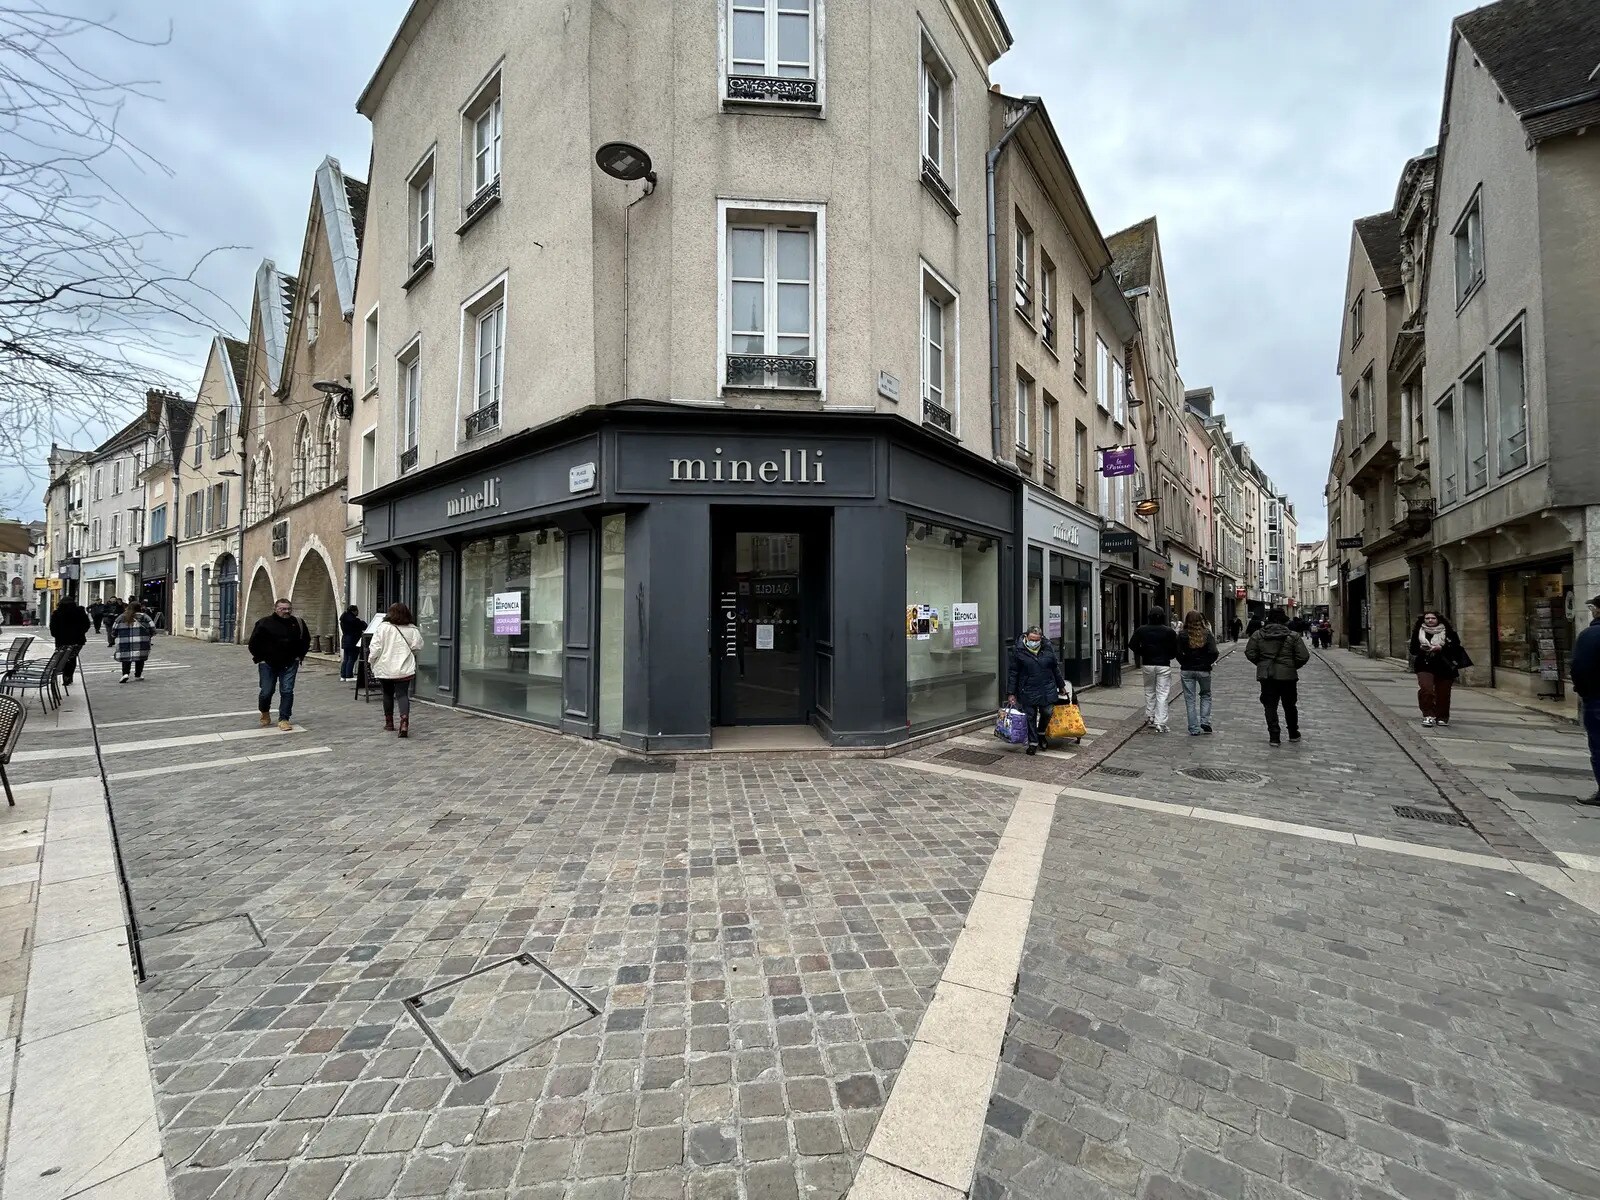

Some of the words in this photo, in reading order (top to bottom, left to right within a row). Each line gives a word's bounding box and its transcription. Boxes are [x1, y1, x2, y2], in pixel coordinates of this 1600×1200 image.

[669, 447, 826, 484] minelli
[1052, 520, 1080, 546] minelli
[1105, 538, 1133, 547] minelli
[721, 592, 736, 657] minelli
[960, 612, 977, 621] FONCIA
